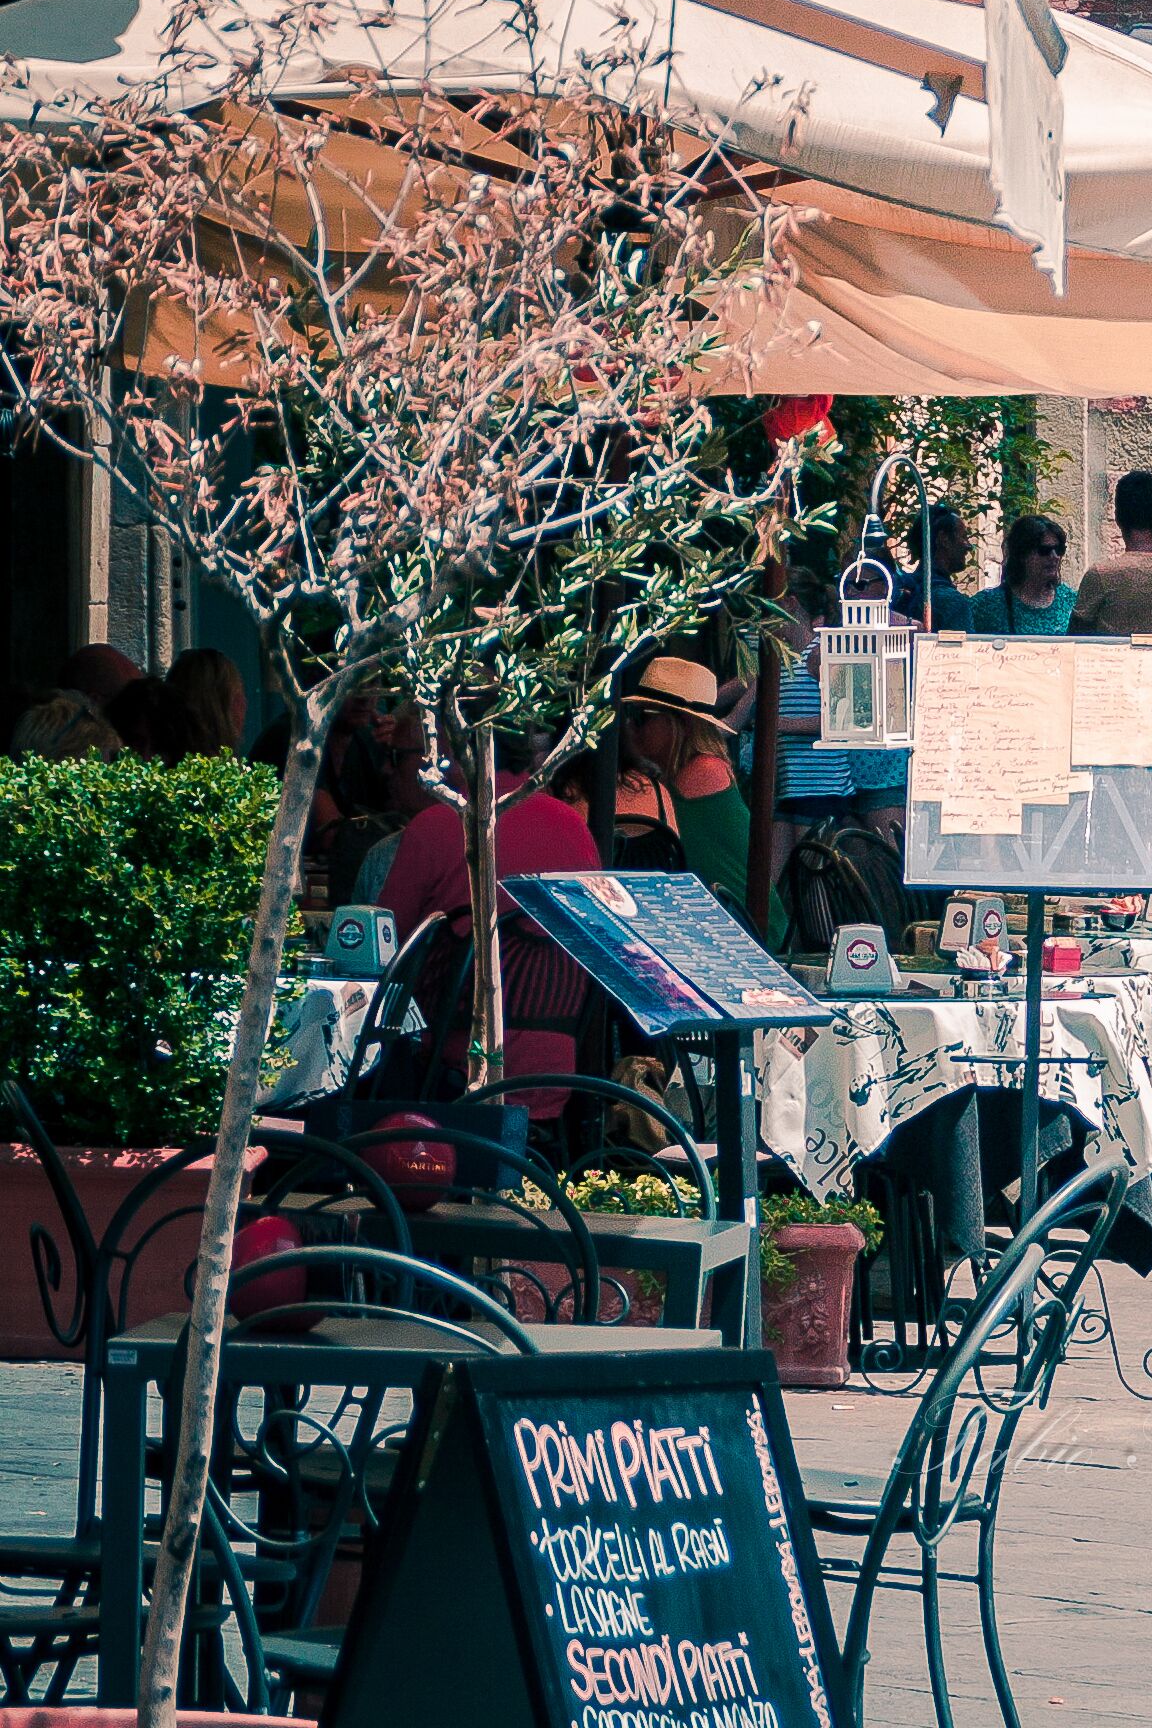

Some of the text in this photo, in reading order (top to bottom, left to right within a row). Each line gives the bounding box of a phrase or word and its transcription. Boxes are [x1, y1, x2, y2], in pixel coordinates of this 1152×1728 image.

[401, 1161, 447, 1172] MARTINI
[513, 1417, 724, 1509] PRIMI PIATTI
[649, 1527, 676, 1578] AL
[555, 1581, 654, 1639] LASAGNE
[566, 1634, 684, 1708] SECONDI
[677, 1631, 760, 1704] PIATTI
